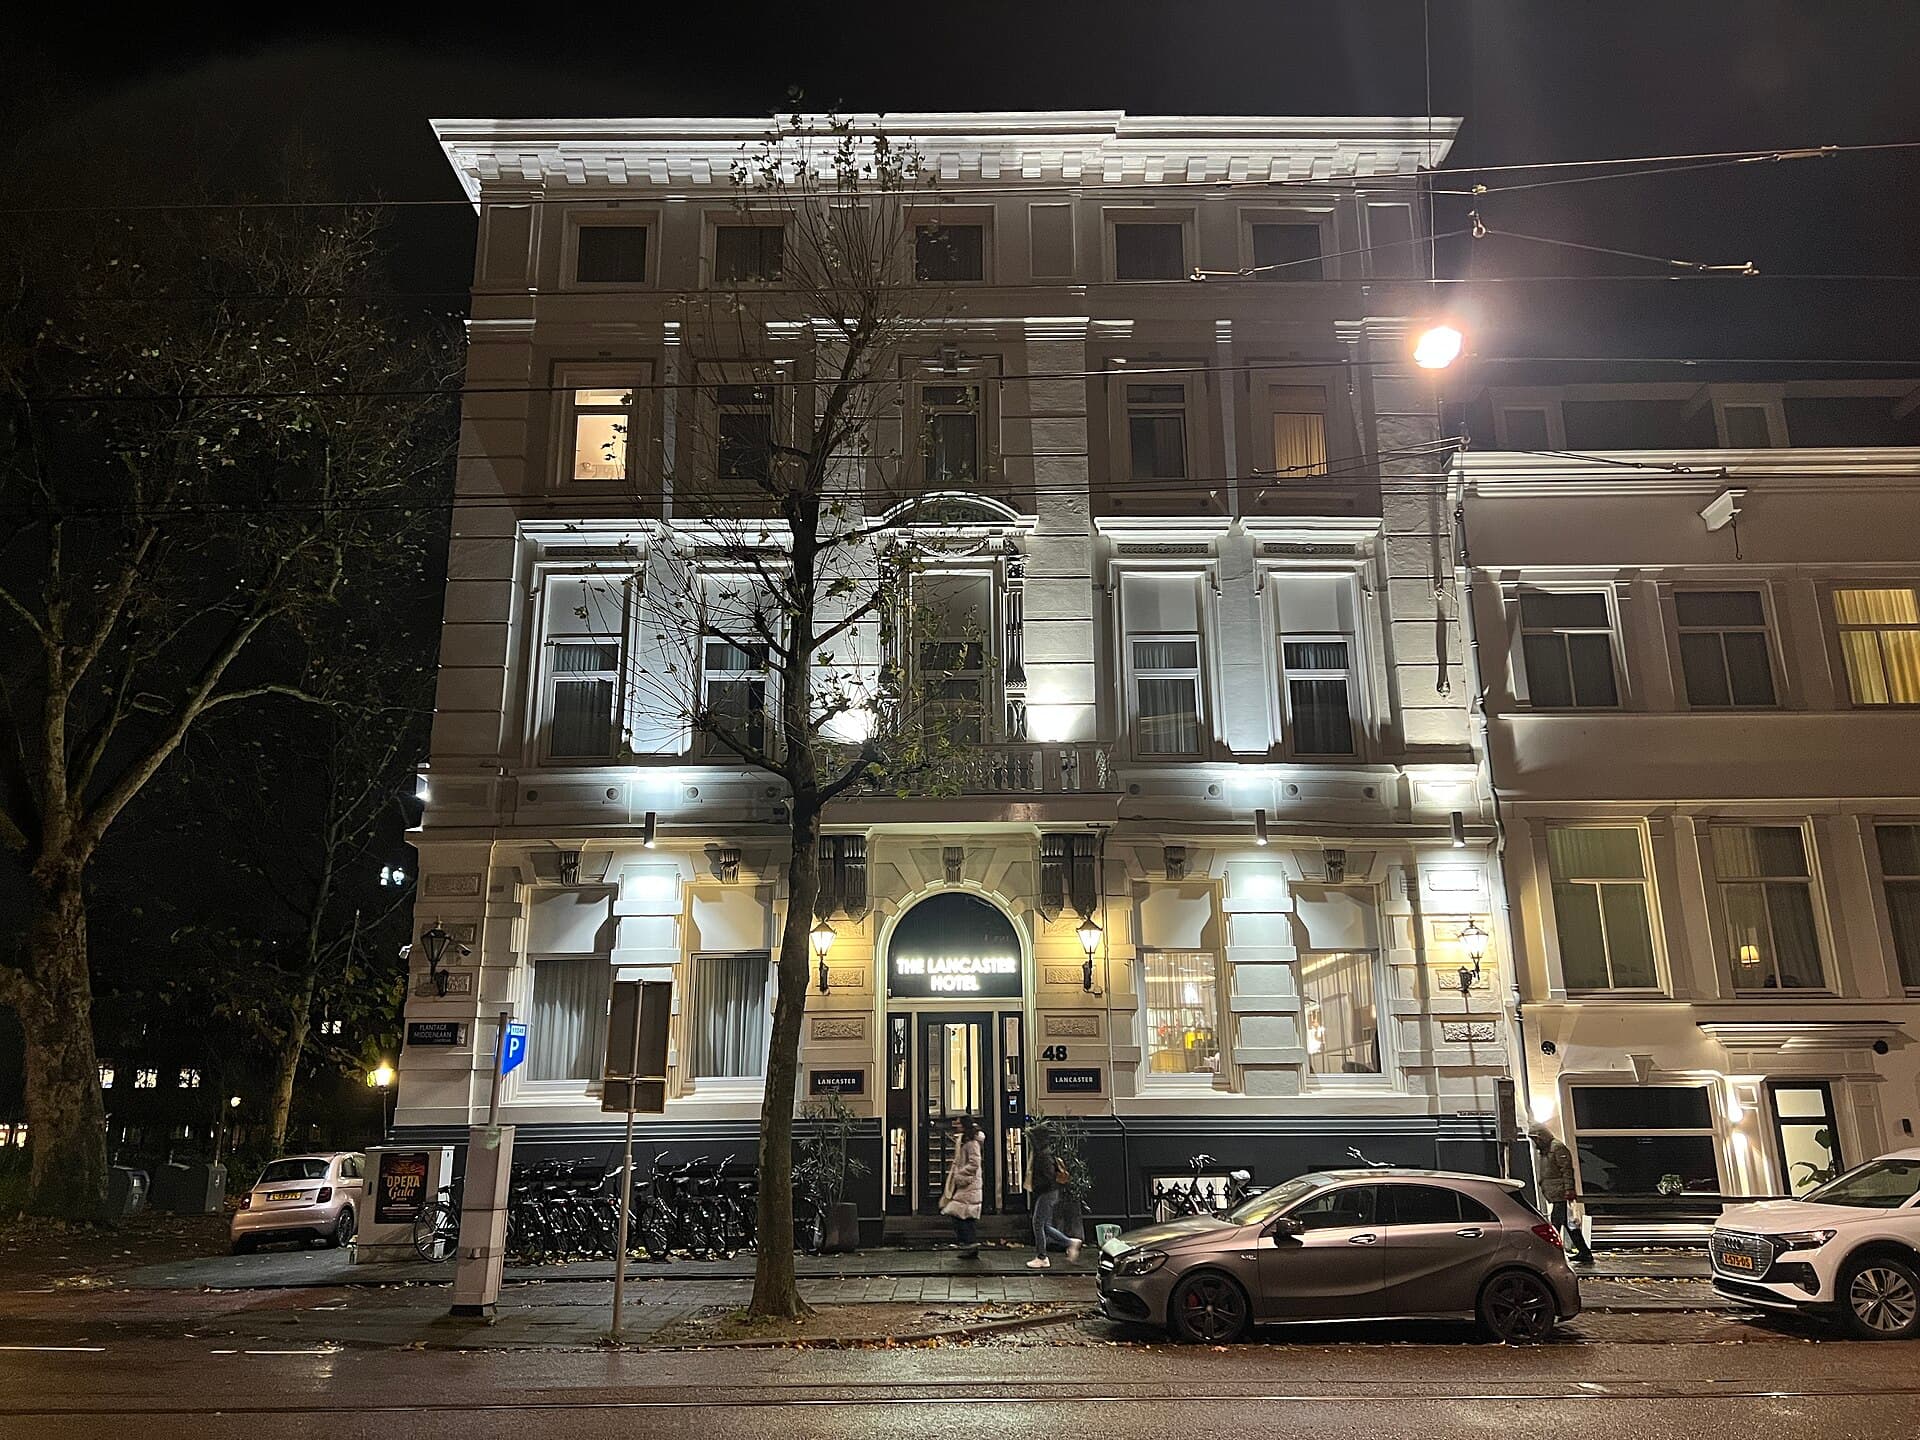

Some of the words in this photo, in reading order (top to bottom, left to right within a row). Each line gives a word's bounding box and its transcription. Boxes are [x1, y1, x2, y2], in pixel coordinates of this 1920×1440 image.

[896, 957, 925, 975] THE
[927, 957, 1017, 974] LANCASTER
[930, 975, 981, 992] HOTEL
[509, 1037, 520, 1058] P
[1042, 1045, 1068, 1061] 48
[386, 1175, 421, 1188] OPERA
[388, 1186, 415, 1201] Gala
